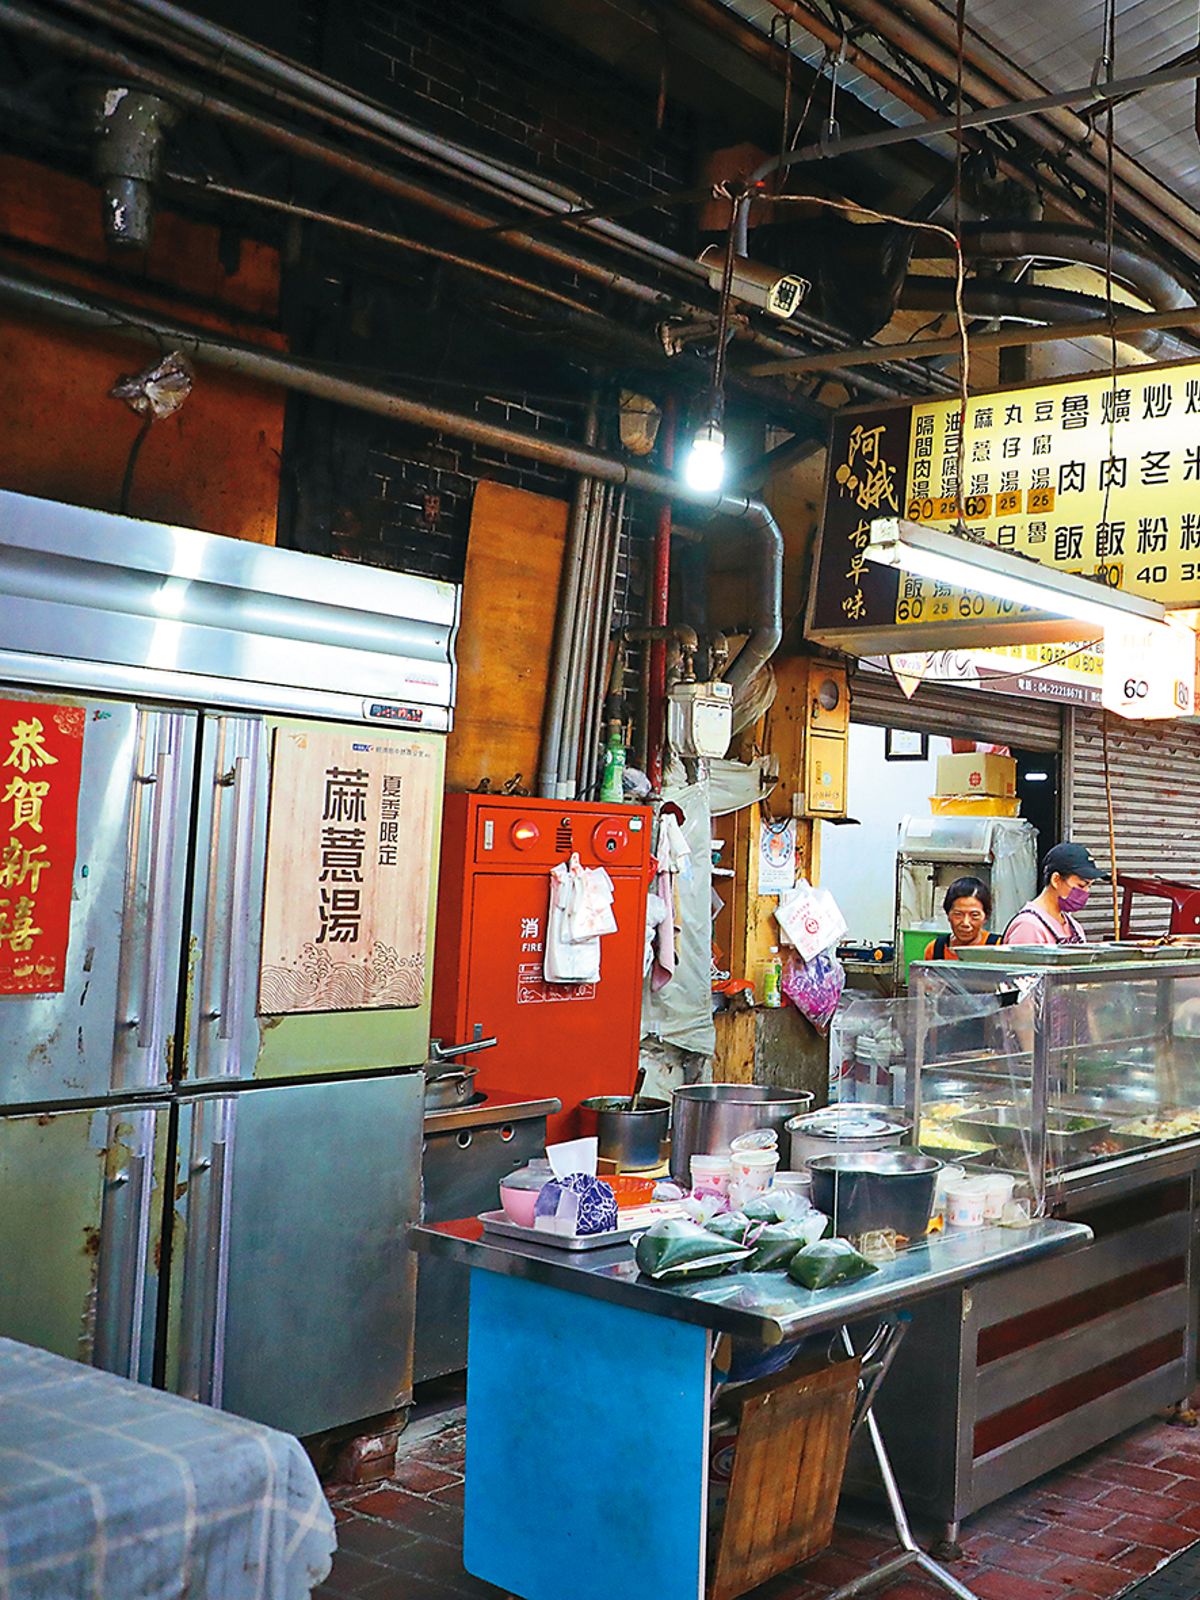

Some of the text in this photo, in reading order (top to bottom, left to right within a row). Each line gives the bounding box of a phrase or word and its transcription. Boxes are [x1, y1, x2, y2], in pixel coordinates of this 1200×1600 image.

[1000, 404, 1023, 493] 丸仔湯
[1030, 400, 1055, 490] 豆腐湯
[848, 424, 899, 513] 阿娥
[1054, 395, 1090, 561] 魯肉飯
[1095, 388, 1131, 558] 爌肉飯
[1137, 383, 1172, 554] 炒冬粉
[908, 499, 934, 521] 60
[964, 497, 987, 517] 60
[999, 496, 1017, 510] 25
[1031, 494, 1049, 508] 25
[1137, 566, 1167, 584] 40
[896, 599, 922, 621] 60
[932, 602, 949, 615] 25
[958, 595, 986, 617] 60
[1124, 678, 1149, 699] 60
[378, 774, 402, 867] 夏季限定
[0, 717, 58, 952] 恭賀新禧
[521, 942, 543, 952] FIRE
